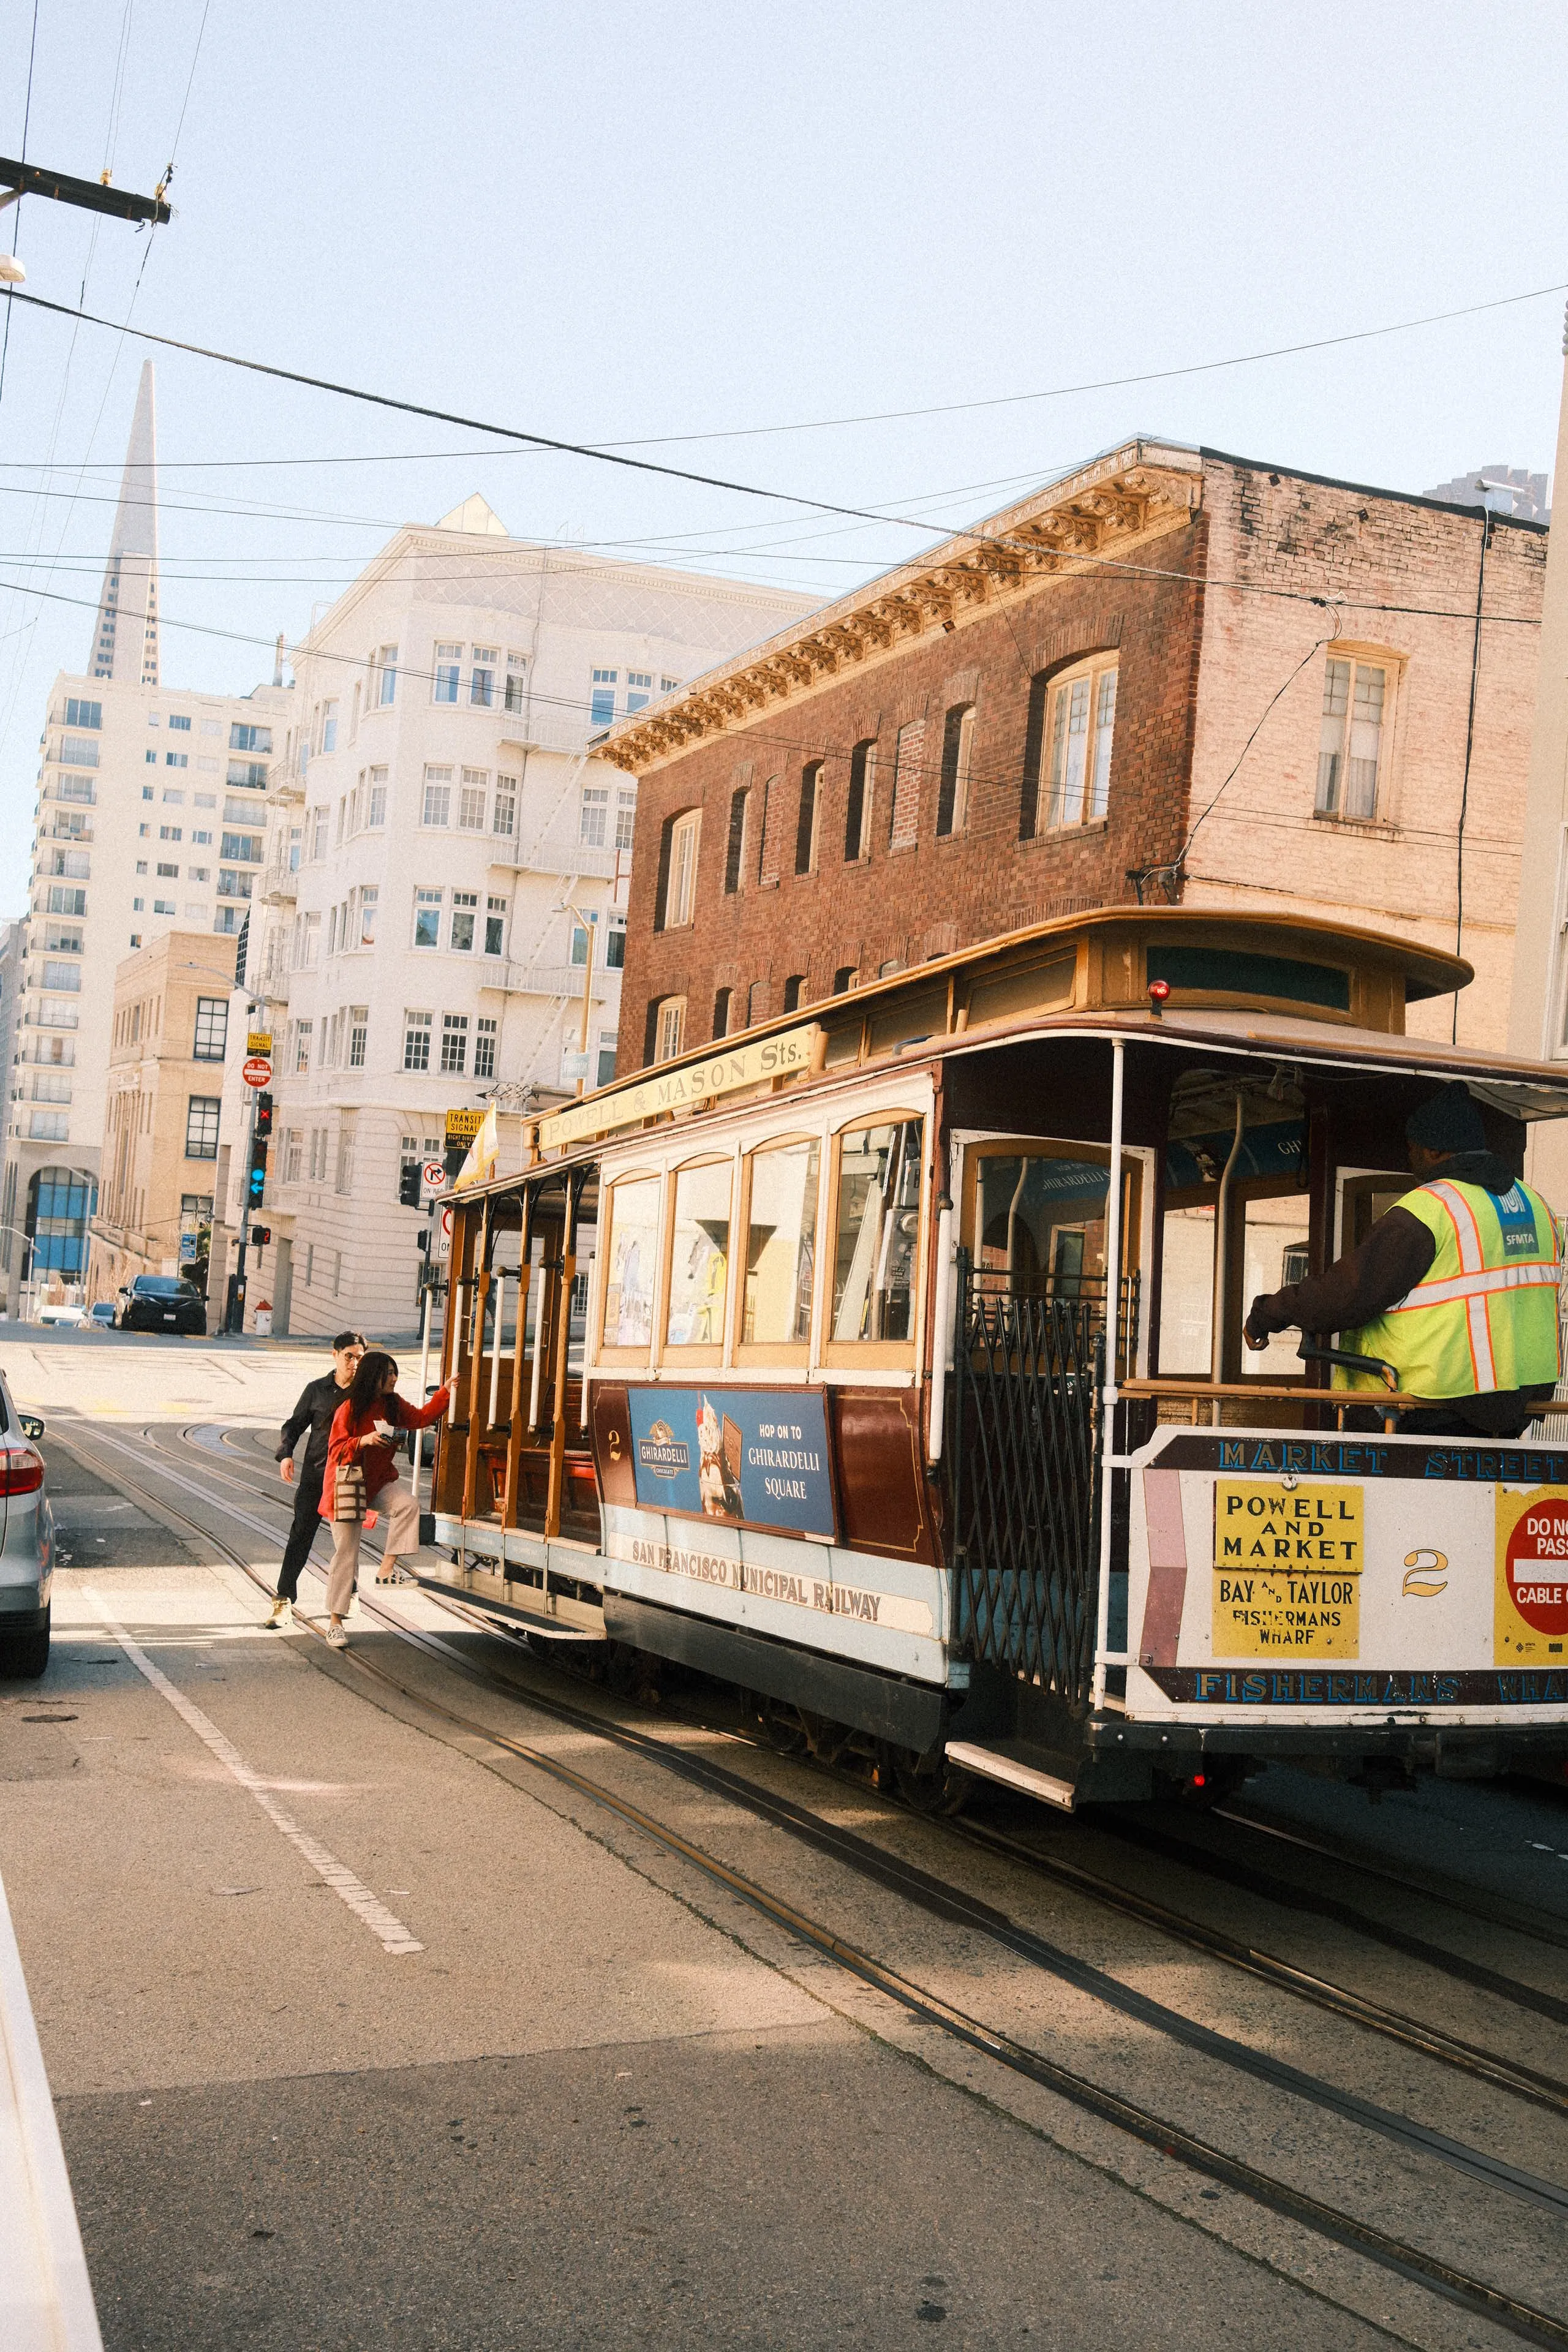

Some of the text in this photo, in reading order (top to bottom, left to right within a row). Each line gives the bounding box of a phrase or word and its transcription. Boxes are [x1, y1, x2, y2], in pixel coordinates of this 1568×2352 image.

[548, 1041, 802, 1143] POWELL & MASON Sts.
[450, 1114, 481, 1123] TRANSIT
[451, 1123, 478, 1133] SIGNAL
[1506, 1234, 1534, 1245] SFMTA
[759, 1424, 802, 1440] HOP ON TO
[609, 1430, 621, 1461] 2
[641, 1446, 687, 1464] GHIRARDELLI
[748, 1447, 820, 1471] GHIRARDELLI
[1219, 1441, 1564, 1481] MARKET STREET
[764, 1477, 807, 1500] SQUARE
[1227, 1496, 1354, 1520] POWELL
[1261, 1521, 1324, 1536] AND
[1527, 1518, 1568, 1536] DO N
[1224, 1537, 1357, 1560] MARKET
[1537, 1537, 1568, 1555] PAS
[633, 1540, 655, 1565] SAN
[658, 1547, 727, 1583] FRANCISCO
[813, 1582, 881, 1622] RAILWAY
[1402, 1549, 1448, 1597] 2
[1220, 1580, 1353, 1604] BAY AND TAYLOR
[1517, 1587, 1561, 1604] CABLE
[1259, 1629, 1315, 1645] WHARF
[1195, 1672, 1568, 1703] FISHERMANS WHA
